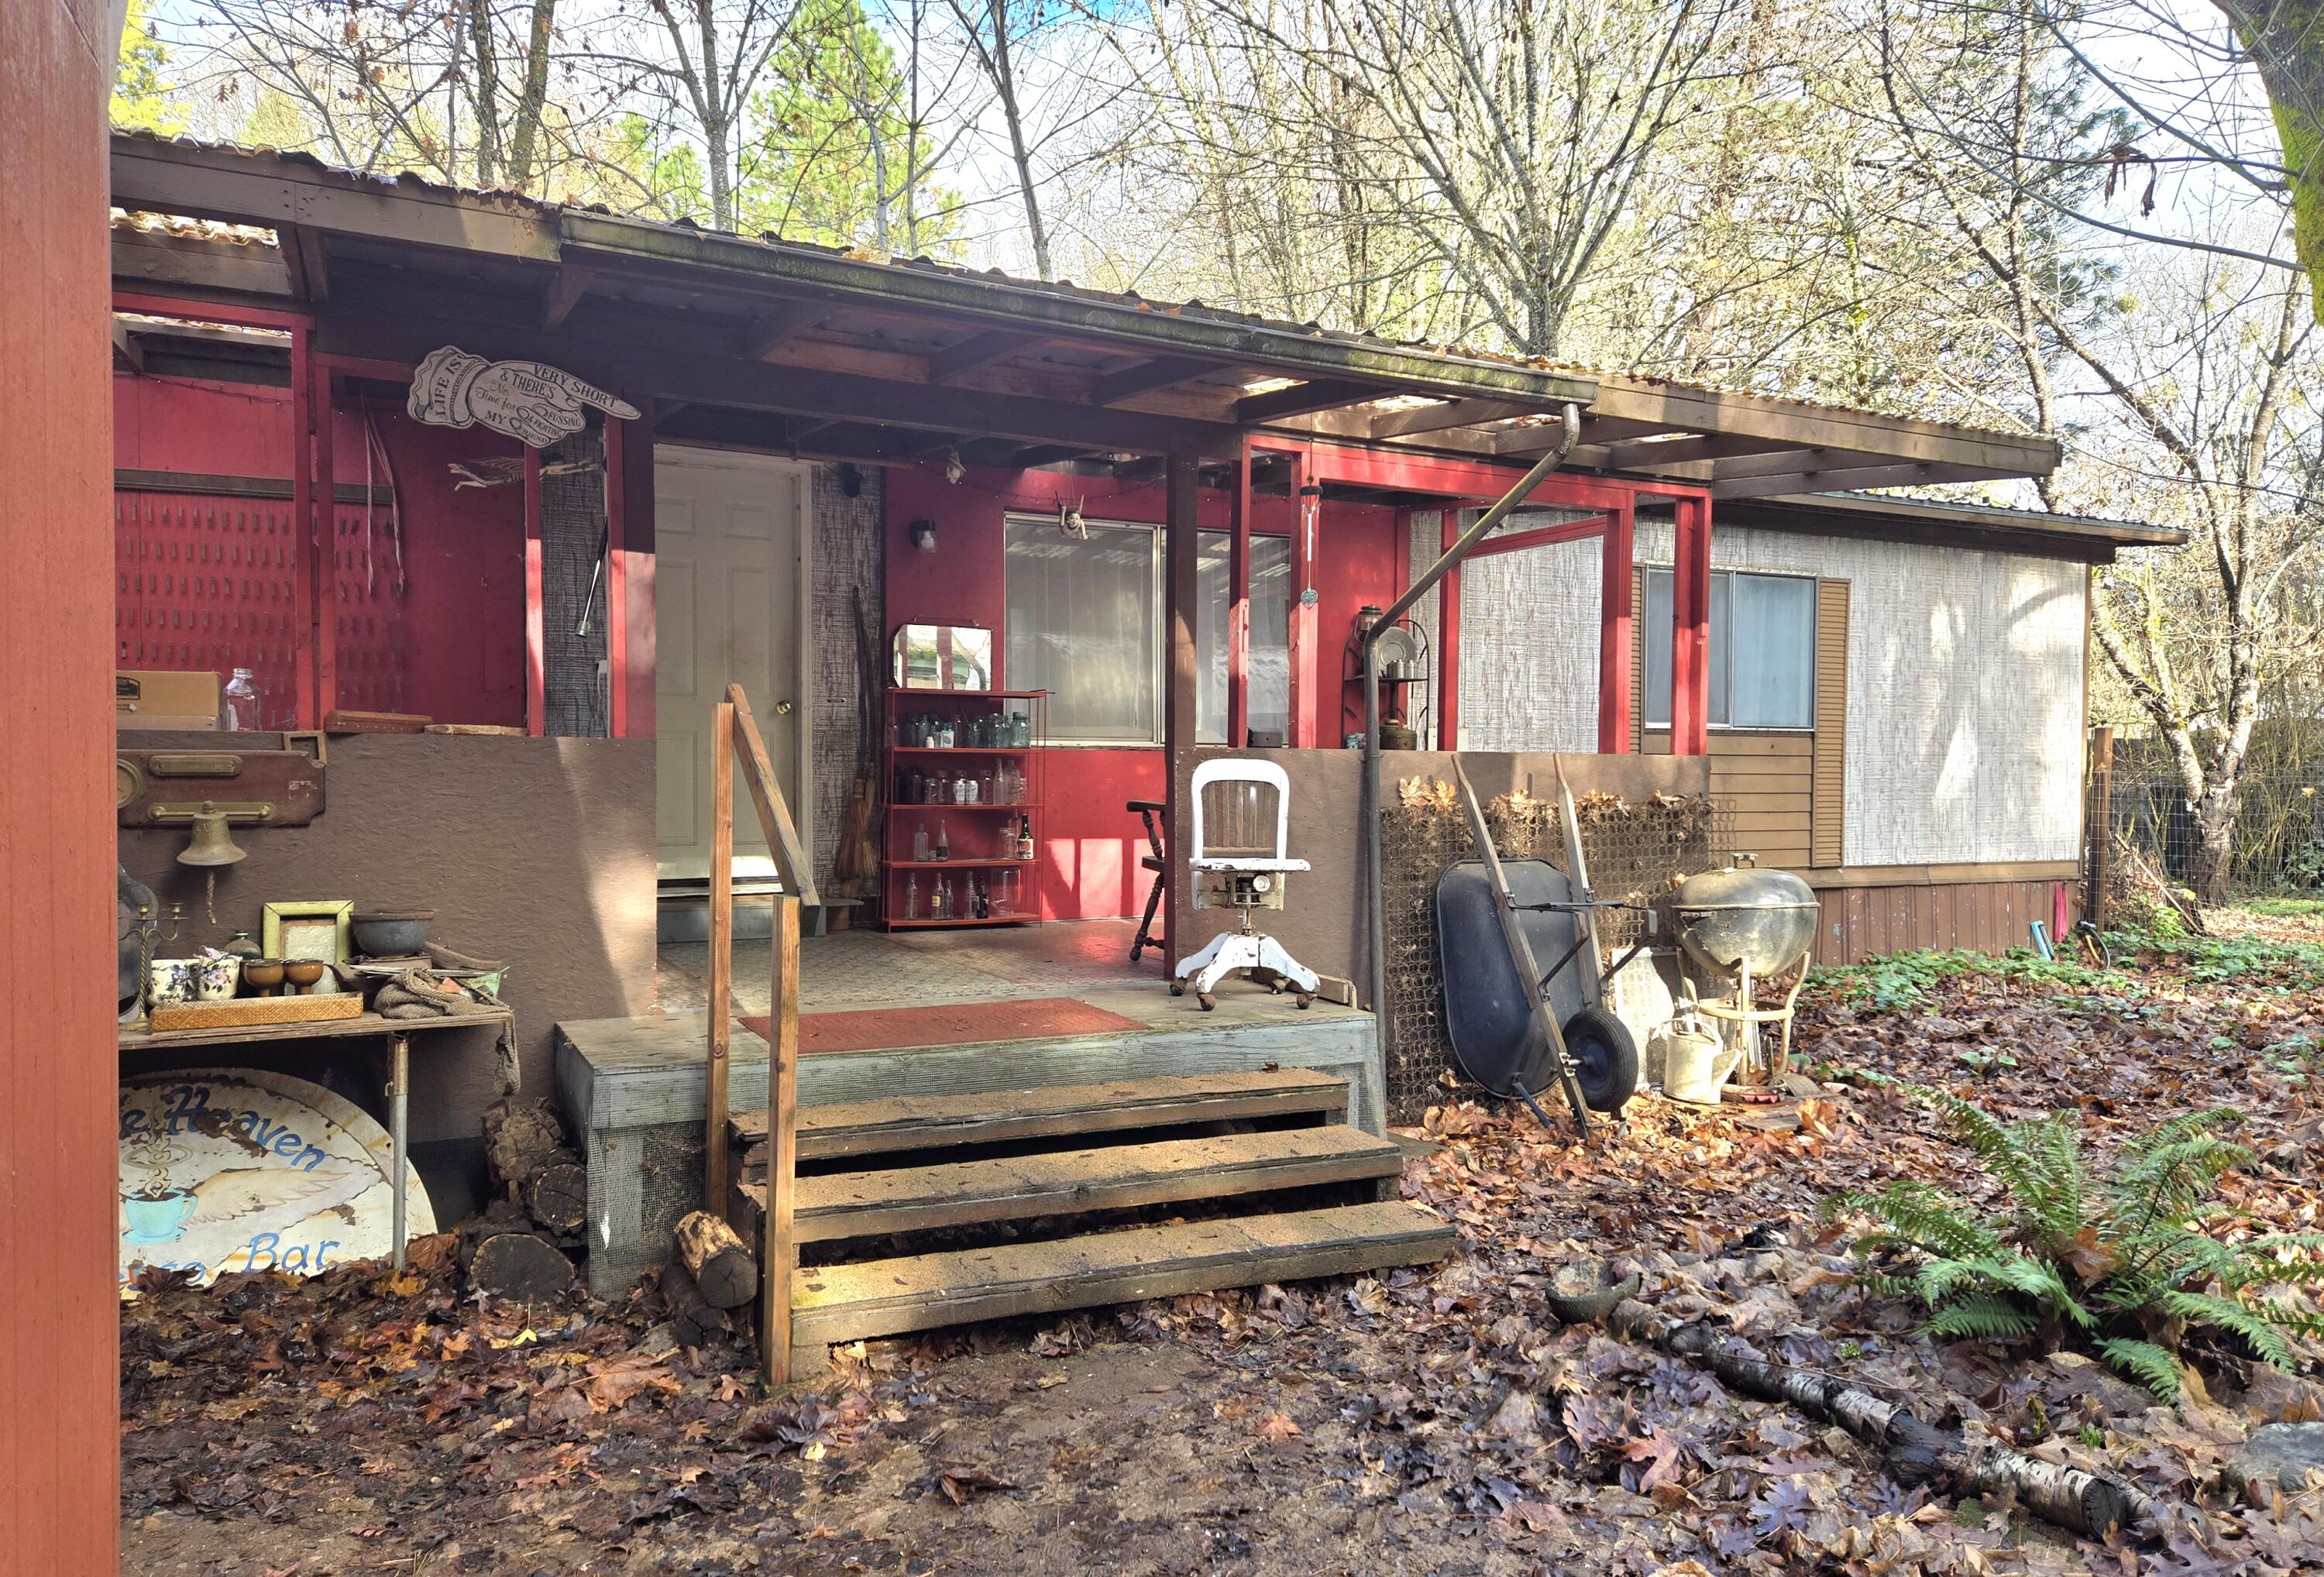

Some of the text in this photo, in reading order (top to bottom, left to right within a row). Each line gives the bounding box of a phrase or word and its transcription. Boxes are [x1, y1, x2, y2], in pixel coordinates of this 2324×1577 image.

[435, 358, 462, 416] LIFE IS
[490, 380, 509, 396] No
[500, 370, 556, 400] & THERE'S
[535, 364, 618, 408] VERY SHORT
[476, 387, 516, 411] Time for
[485, 410, 507, 424] MY
[534, 419, 563, 438] FIGHTING
[548, 411, 581, 427] FUSSING
[520, 426, 548, 443] FRIEND
[164, 1085, 326, 1173] Heaven
[245, 1232, 341, 1273] Bar
